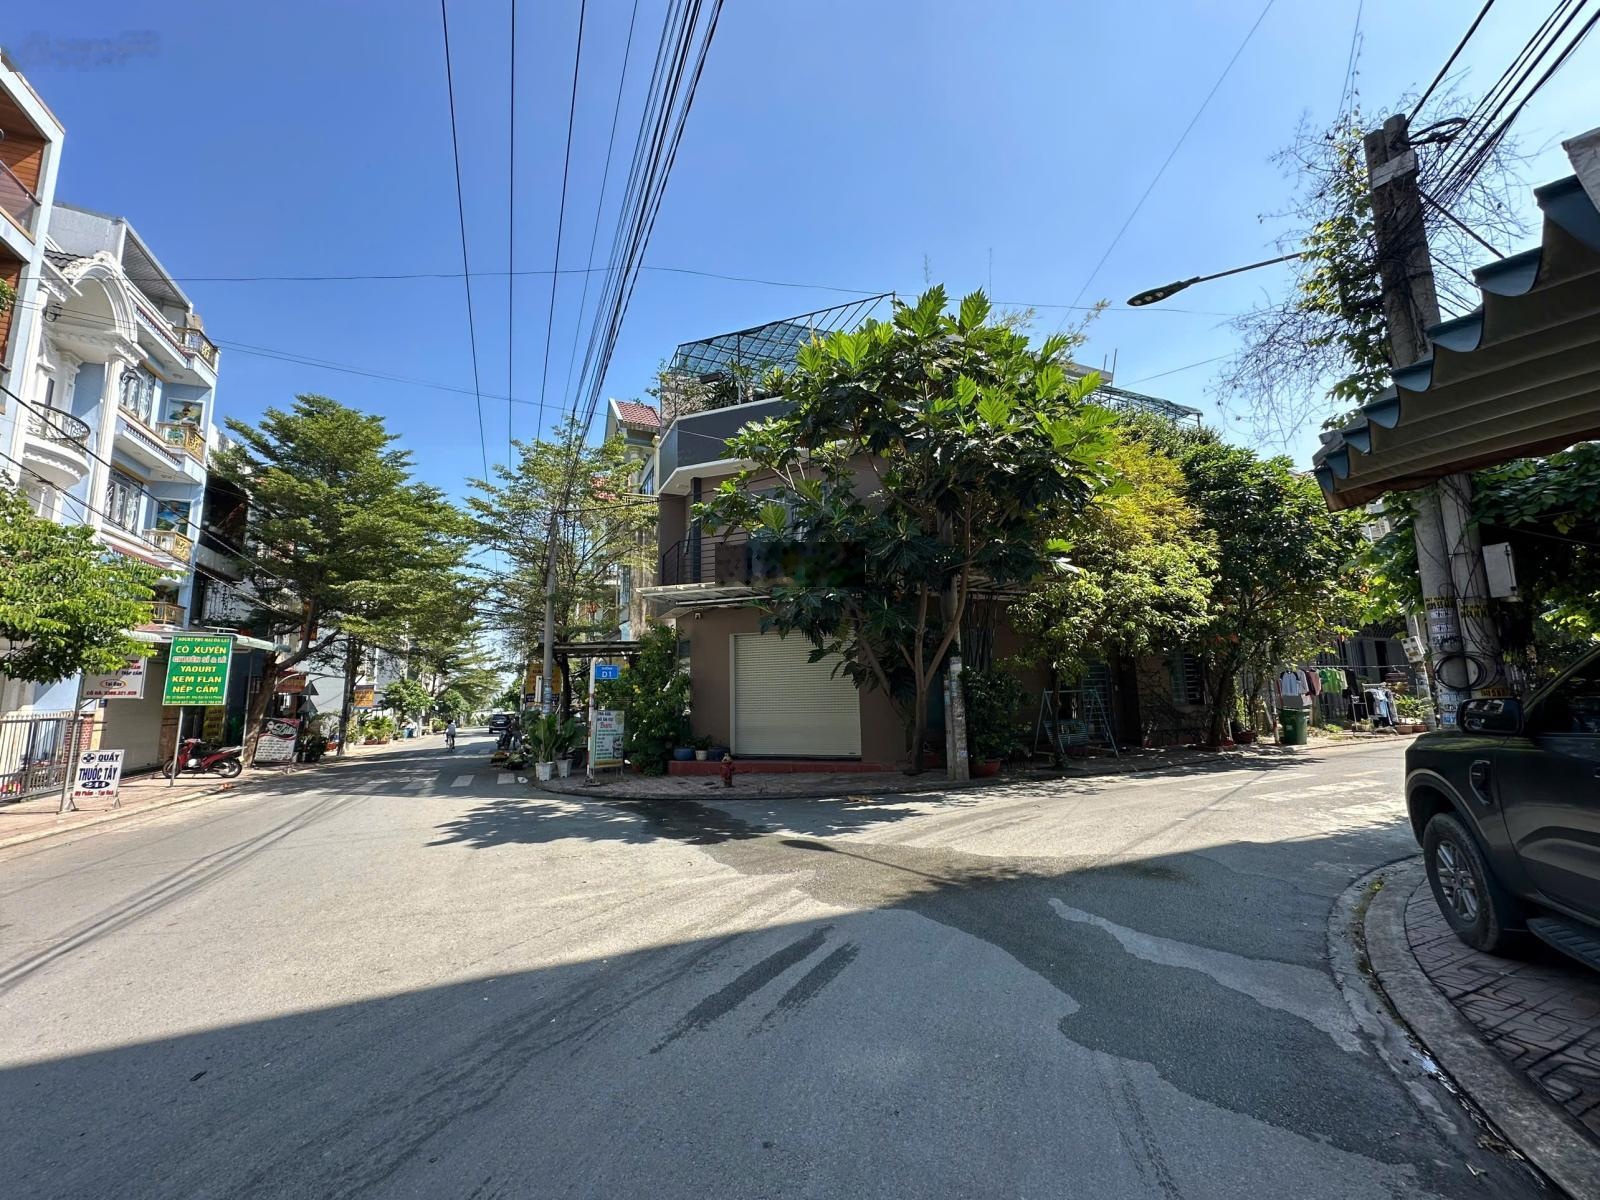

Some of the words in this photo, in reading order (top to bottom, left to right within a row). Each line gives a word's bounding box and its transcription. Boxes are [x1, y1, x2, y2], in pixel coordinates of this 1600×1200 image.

[181, 665, 217, 673] YAOURT
[601, 670, 612, 678] D1
[172, 675, 195, 683] KEM
[78, 763, 103, 781] THUỐC
